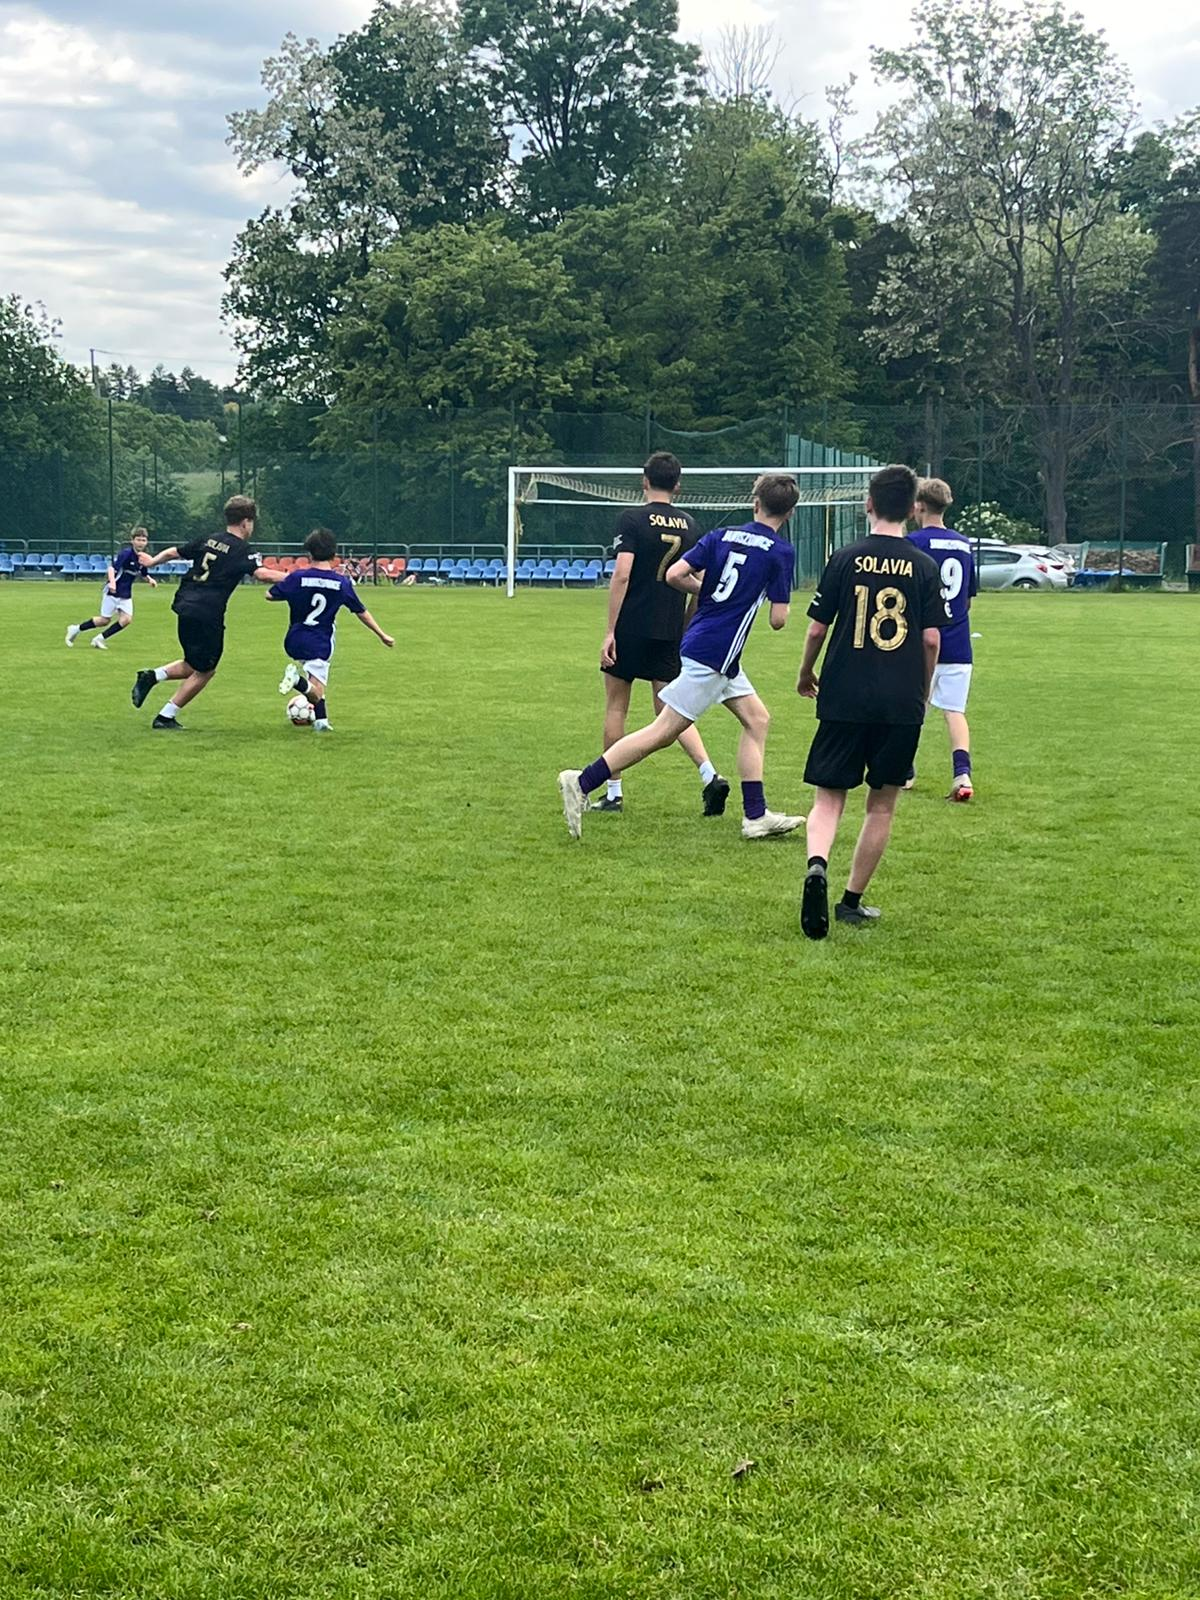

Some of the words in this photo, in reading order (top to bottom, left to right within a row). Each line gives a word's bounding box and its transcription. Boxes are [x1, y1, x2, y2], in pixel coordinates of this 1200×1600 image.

[649, 513, 689, 531] SOLAVIA
[192, 551, 217, 581] 5
[656, 533, 682, 582] 7
[711, 550, 748, 603] 5
[854, 555, 913, 578] SOLAVIA
[940, 557, 963, 601] 9
[303, 592, 327, 626] 2
[853, 585, 909, 651] 18
